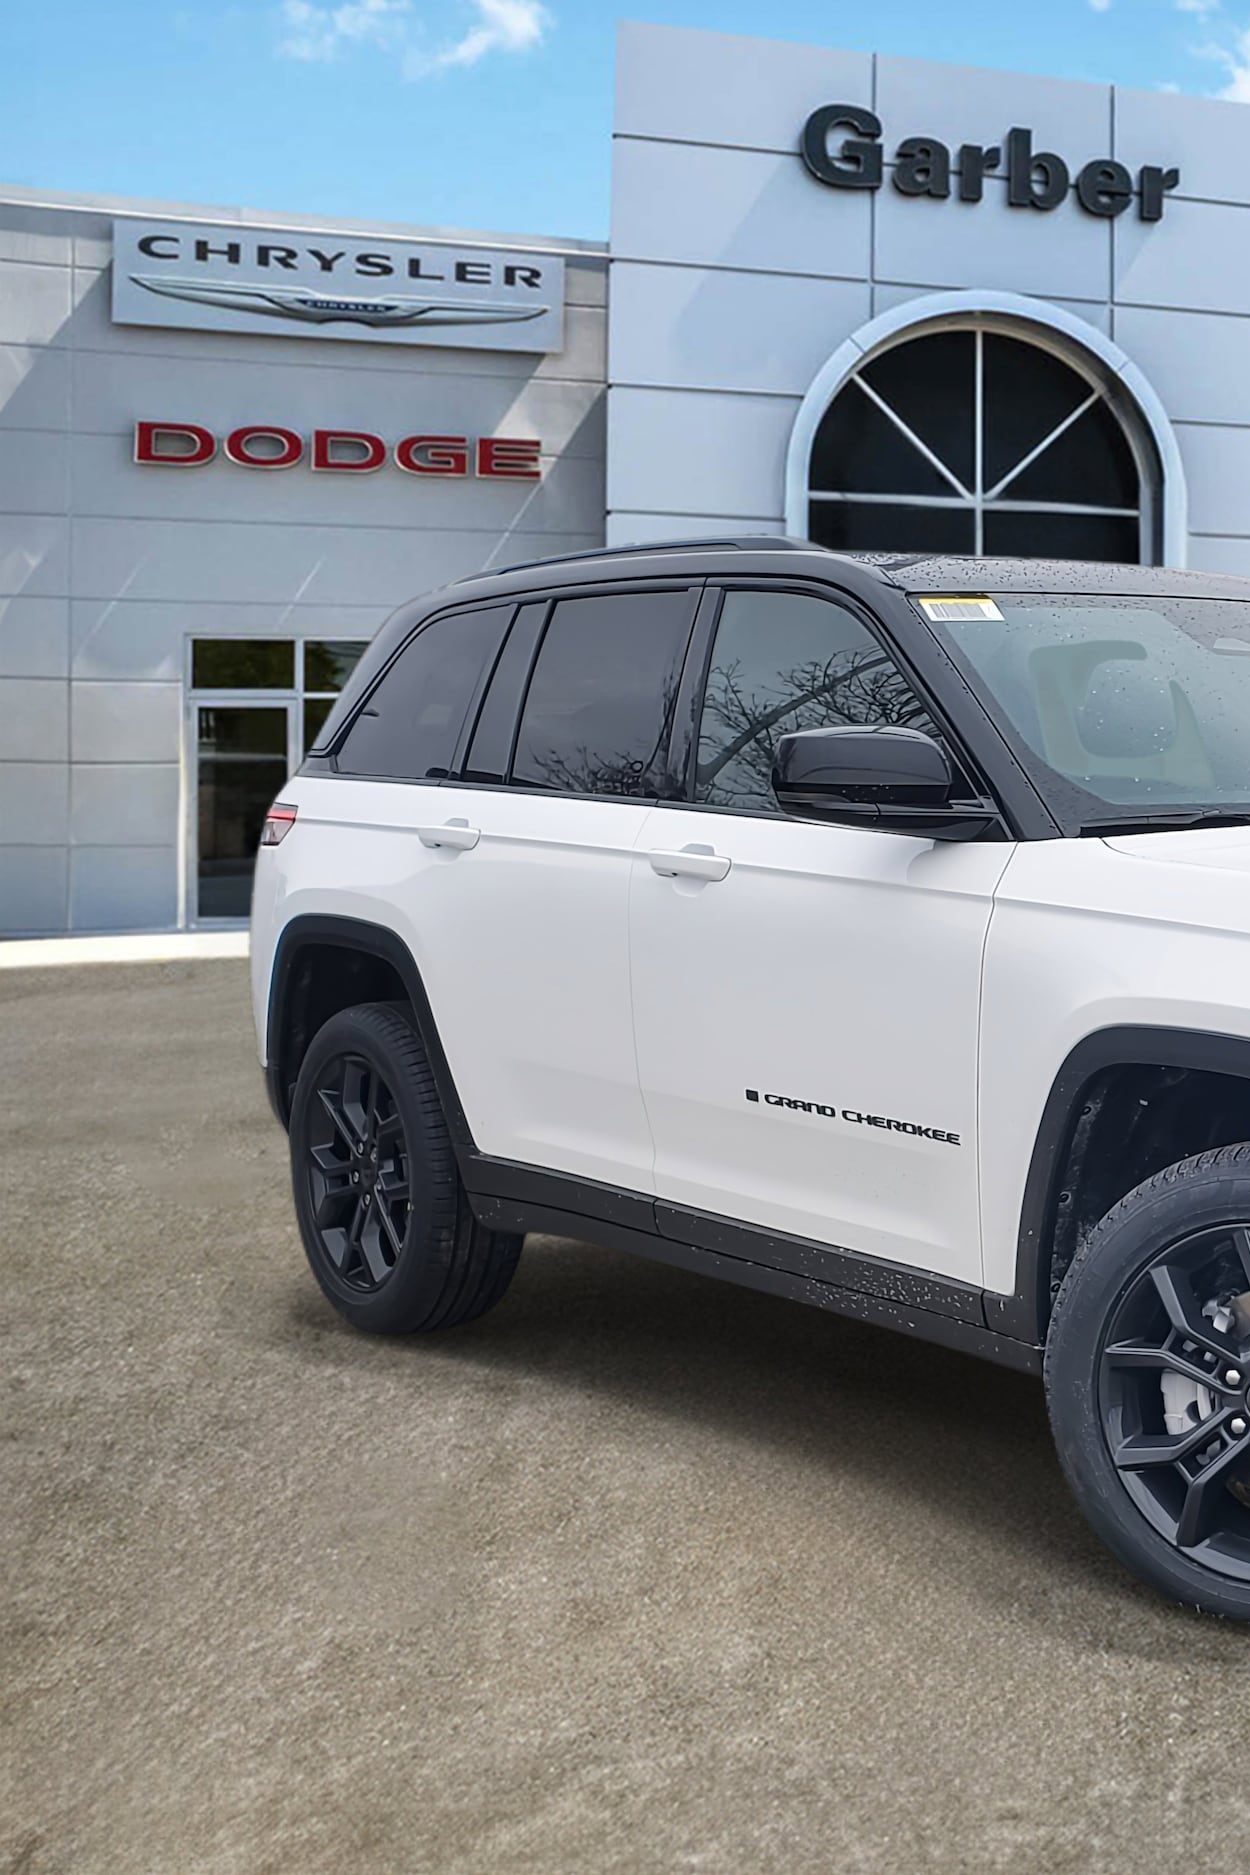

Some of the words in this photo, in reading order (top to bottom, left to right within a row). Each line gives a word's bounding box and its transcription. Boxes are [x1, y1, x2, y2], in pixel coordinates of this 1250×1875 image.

[802, 103, 1180, 222] Garber
[137, 234, 542, 288] CHRYSLER
[133, 420, 543, 480] DODGE
[764, 1094, 836, 1117] GRAND
[841, 1110, 961, 1146] CHEROKEE
